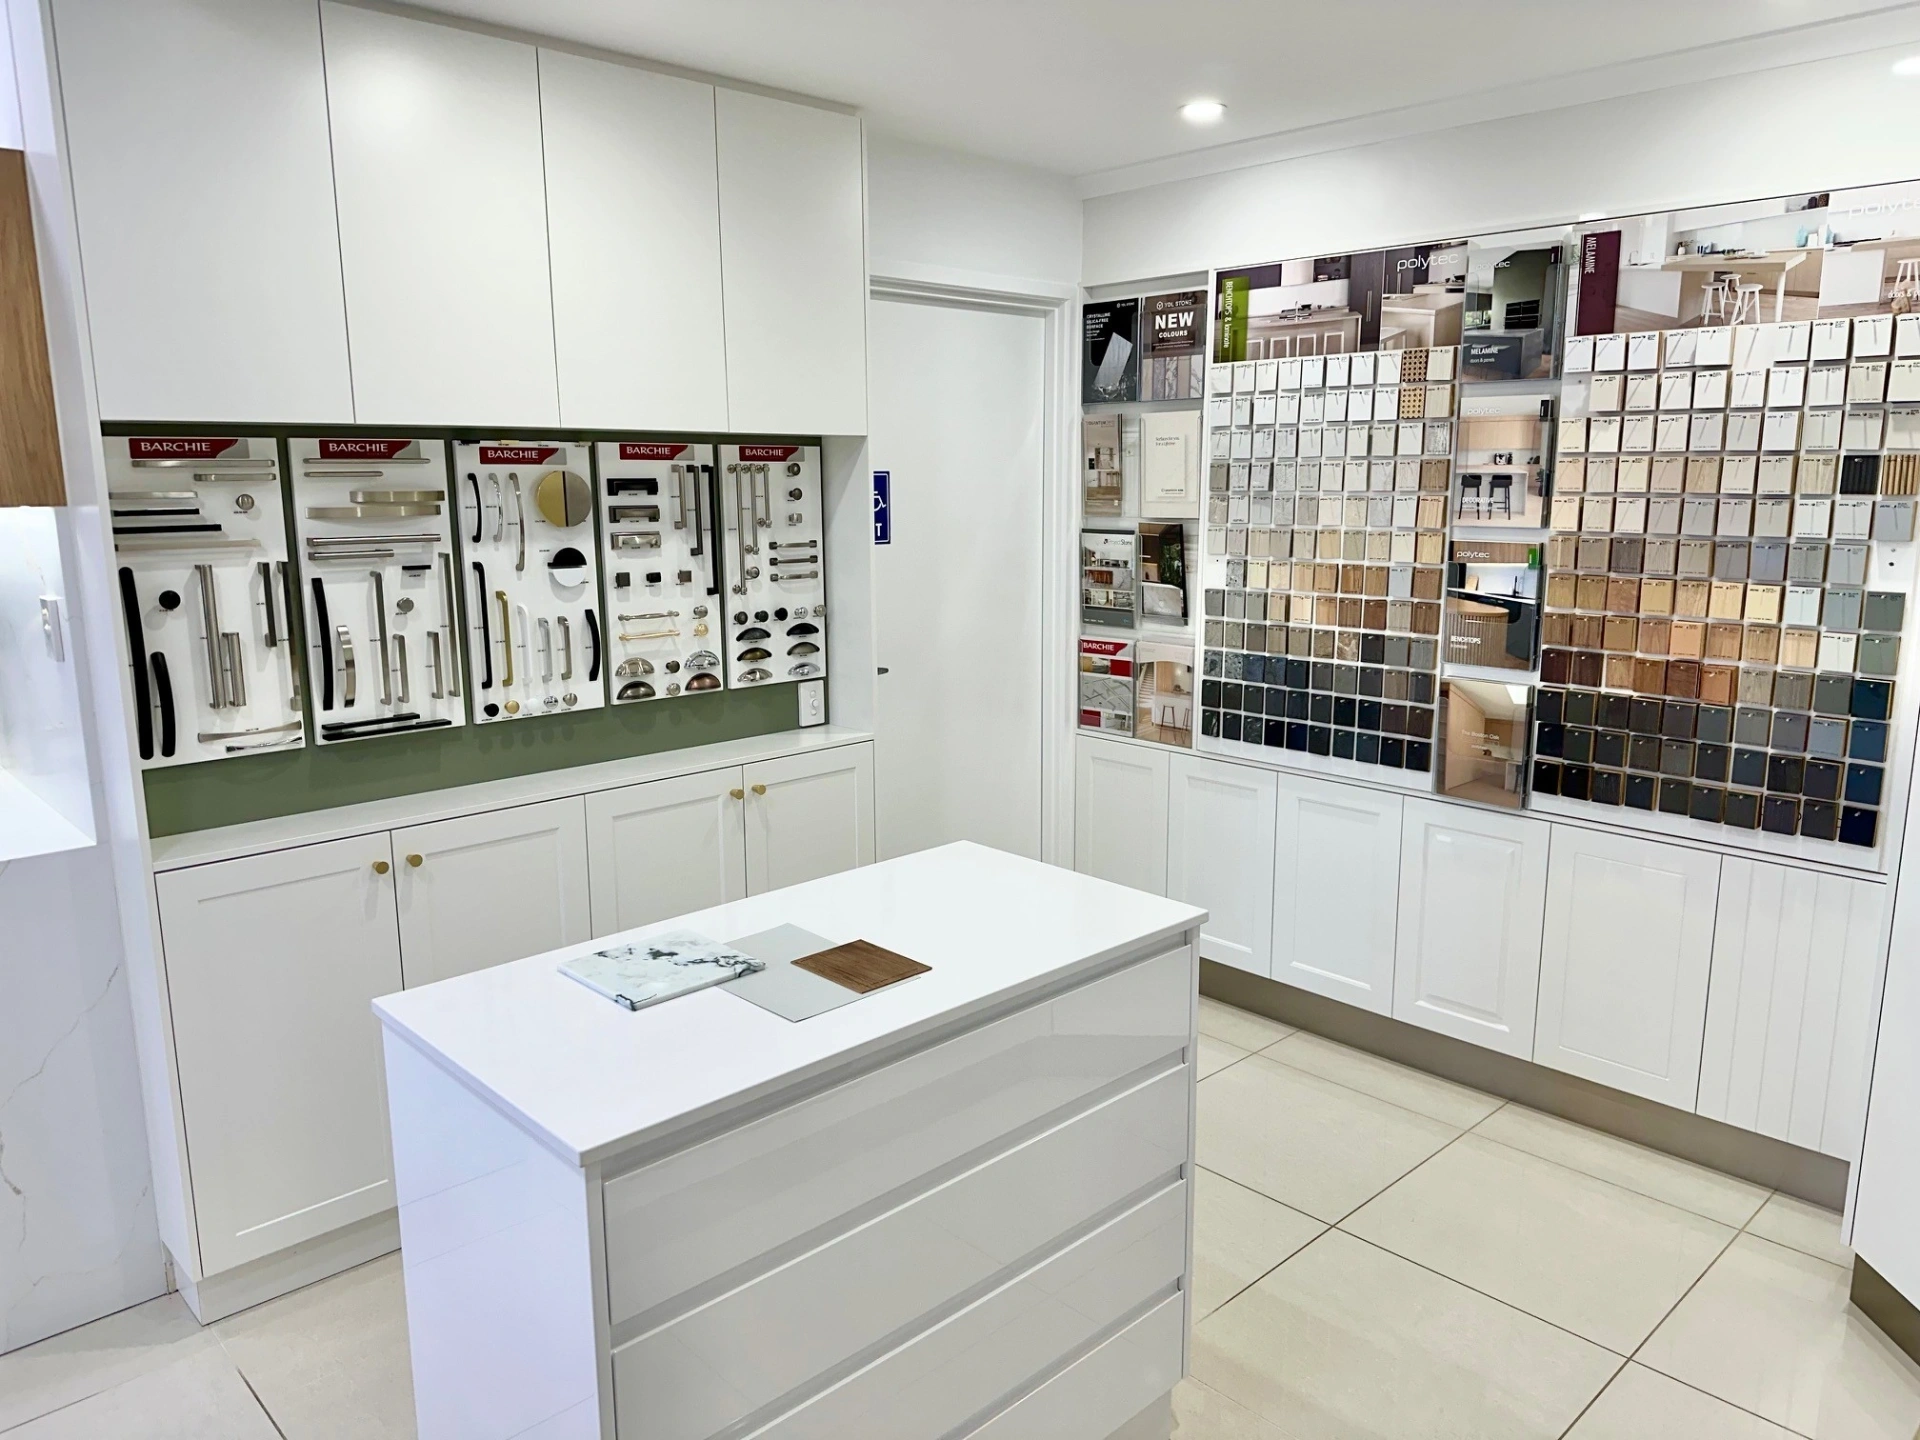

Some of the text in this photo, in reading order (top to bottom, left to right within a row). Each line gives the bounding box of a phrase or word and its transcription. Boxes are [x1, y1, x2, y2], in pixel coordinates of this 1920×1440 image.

[1584, 236, 1597, 275] MELAMINE
[1397, 250, 1459, 272] polytec
[1224, 281, 1234, 315] BENCHTOPS
[1155, 311, 1194, 330] NEW
[1158, 330, 1188, 338] COLOURS
[1223, 324, 1232, 348] laminate
[1470, 346, 1498, 355] MELAMINE
[1467, 407, 1500, 415] polytec
[140, 442, 211, 452] BARCHIE
[328, 442, 388, 453] BARCHIE
[626, 445, 671, 455] BARCHIE
[487, 449, 539, 459] BARCHIE
[745, 448, 784, 457] BARCHIE
[1456, 551, 1490, 559] polytec
[1450, 635, 1481, 644] BENCHTOPS
[1083, 642, 1115, 651] BARCHIE
